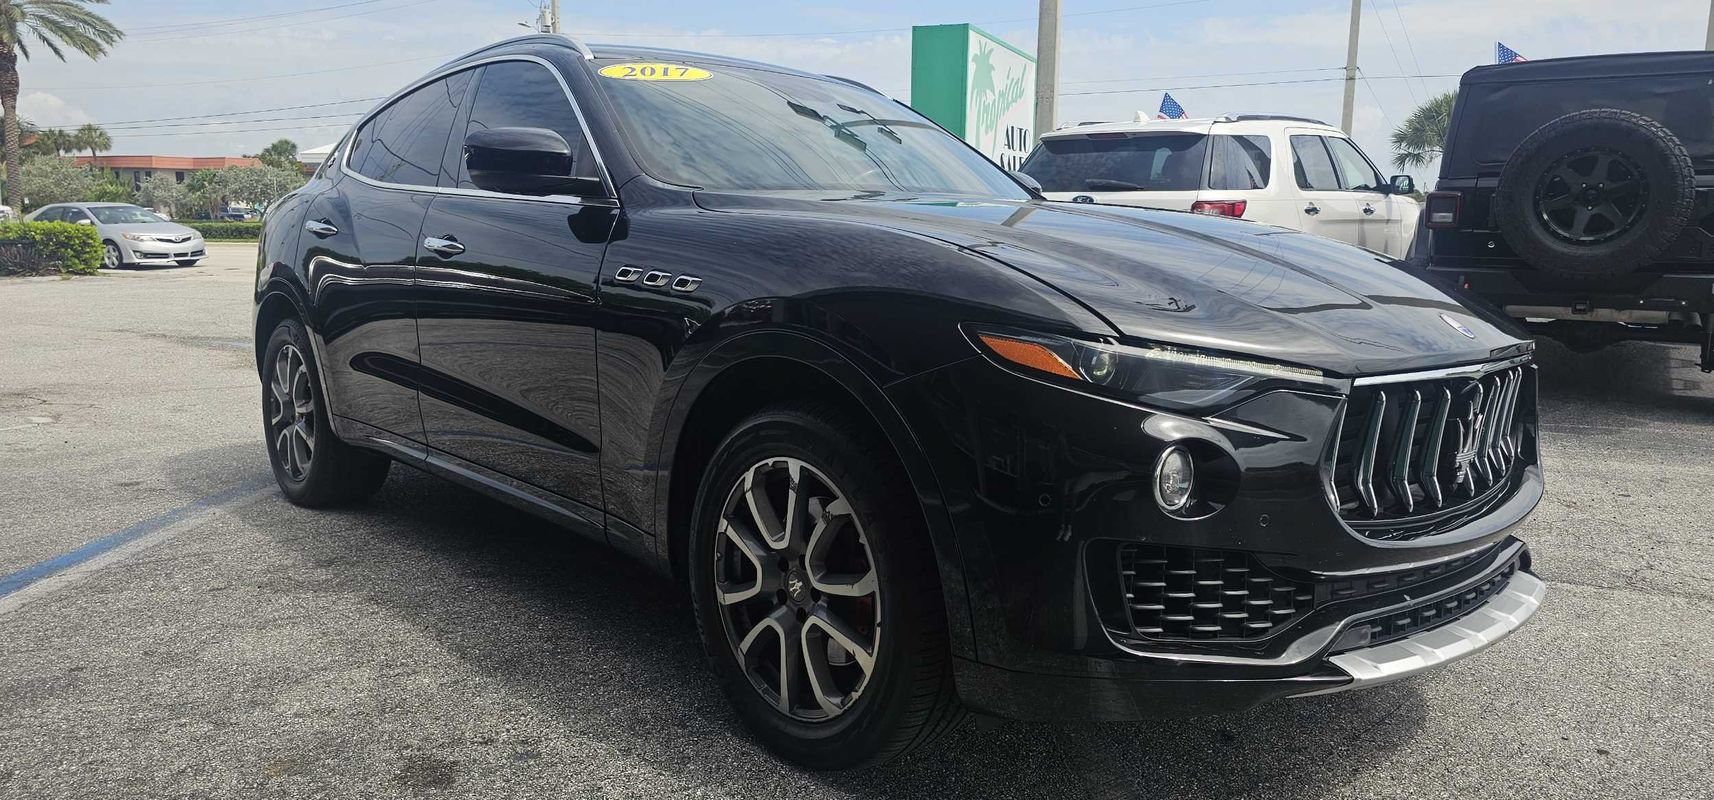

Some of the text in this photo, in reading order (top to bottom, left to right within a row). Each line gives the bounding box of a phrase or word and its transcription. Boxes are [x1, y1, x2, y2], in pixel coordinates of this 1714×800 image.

[622, 66, 689, 77] 2017
[975, 64, 1026, 147] Tropical
[1003, 124, 1031, 154] AUTO
